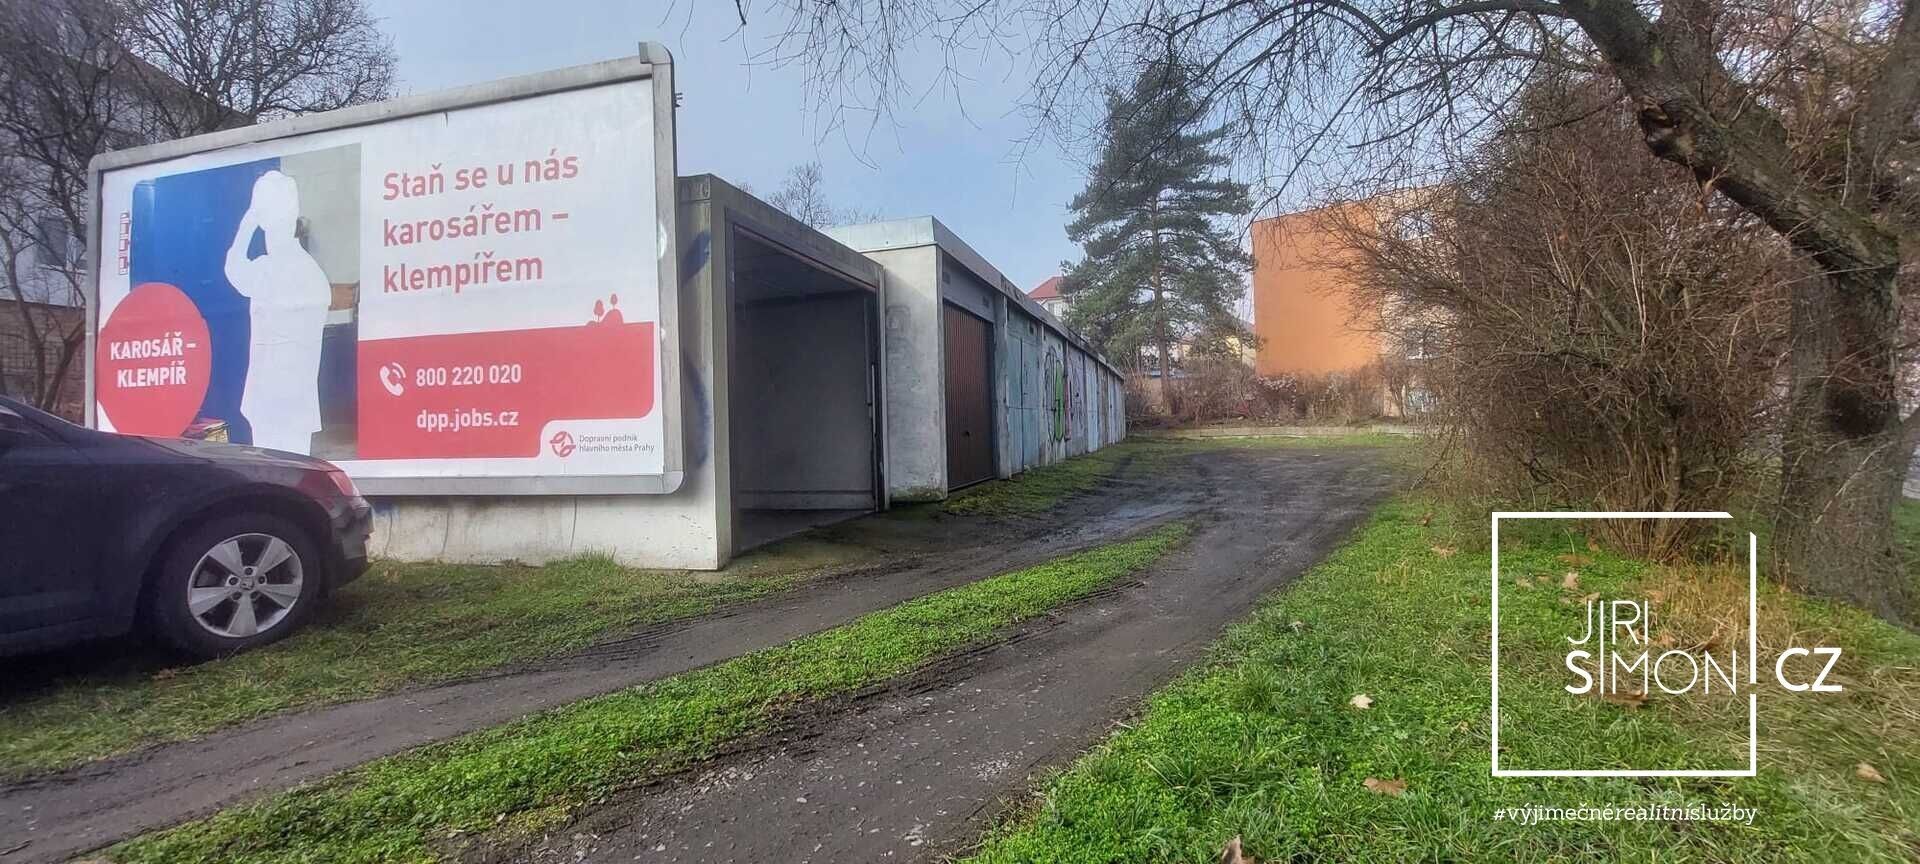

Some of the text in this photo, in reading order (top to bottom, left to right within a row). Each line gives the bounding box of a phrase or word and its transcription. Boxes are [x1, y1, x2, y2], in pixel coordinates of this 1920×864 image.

[383, 148, 579, 201] Staň se u nás
[383, 202, 541, 247] karosářem
[383, 250, 543, 293] klempířem
[110, 331, 184, 361] KAROSÁŘ
[117, 360, 187, 388] KLEMPÍŘ
[416, 364, 522, 387] 800 220 020
[416, 408, 519, 432] dpp.jobs.cz
[634, 443, 655, 453] Prahy
